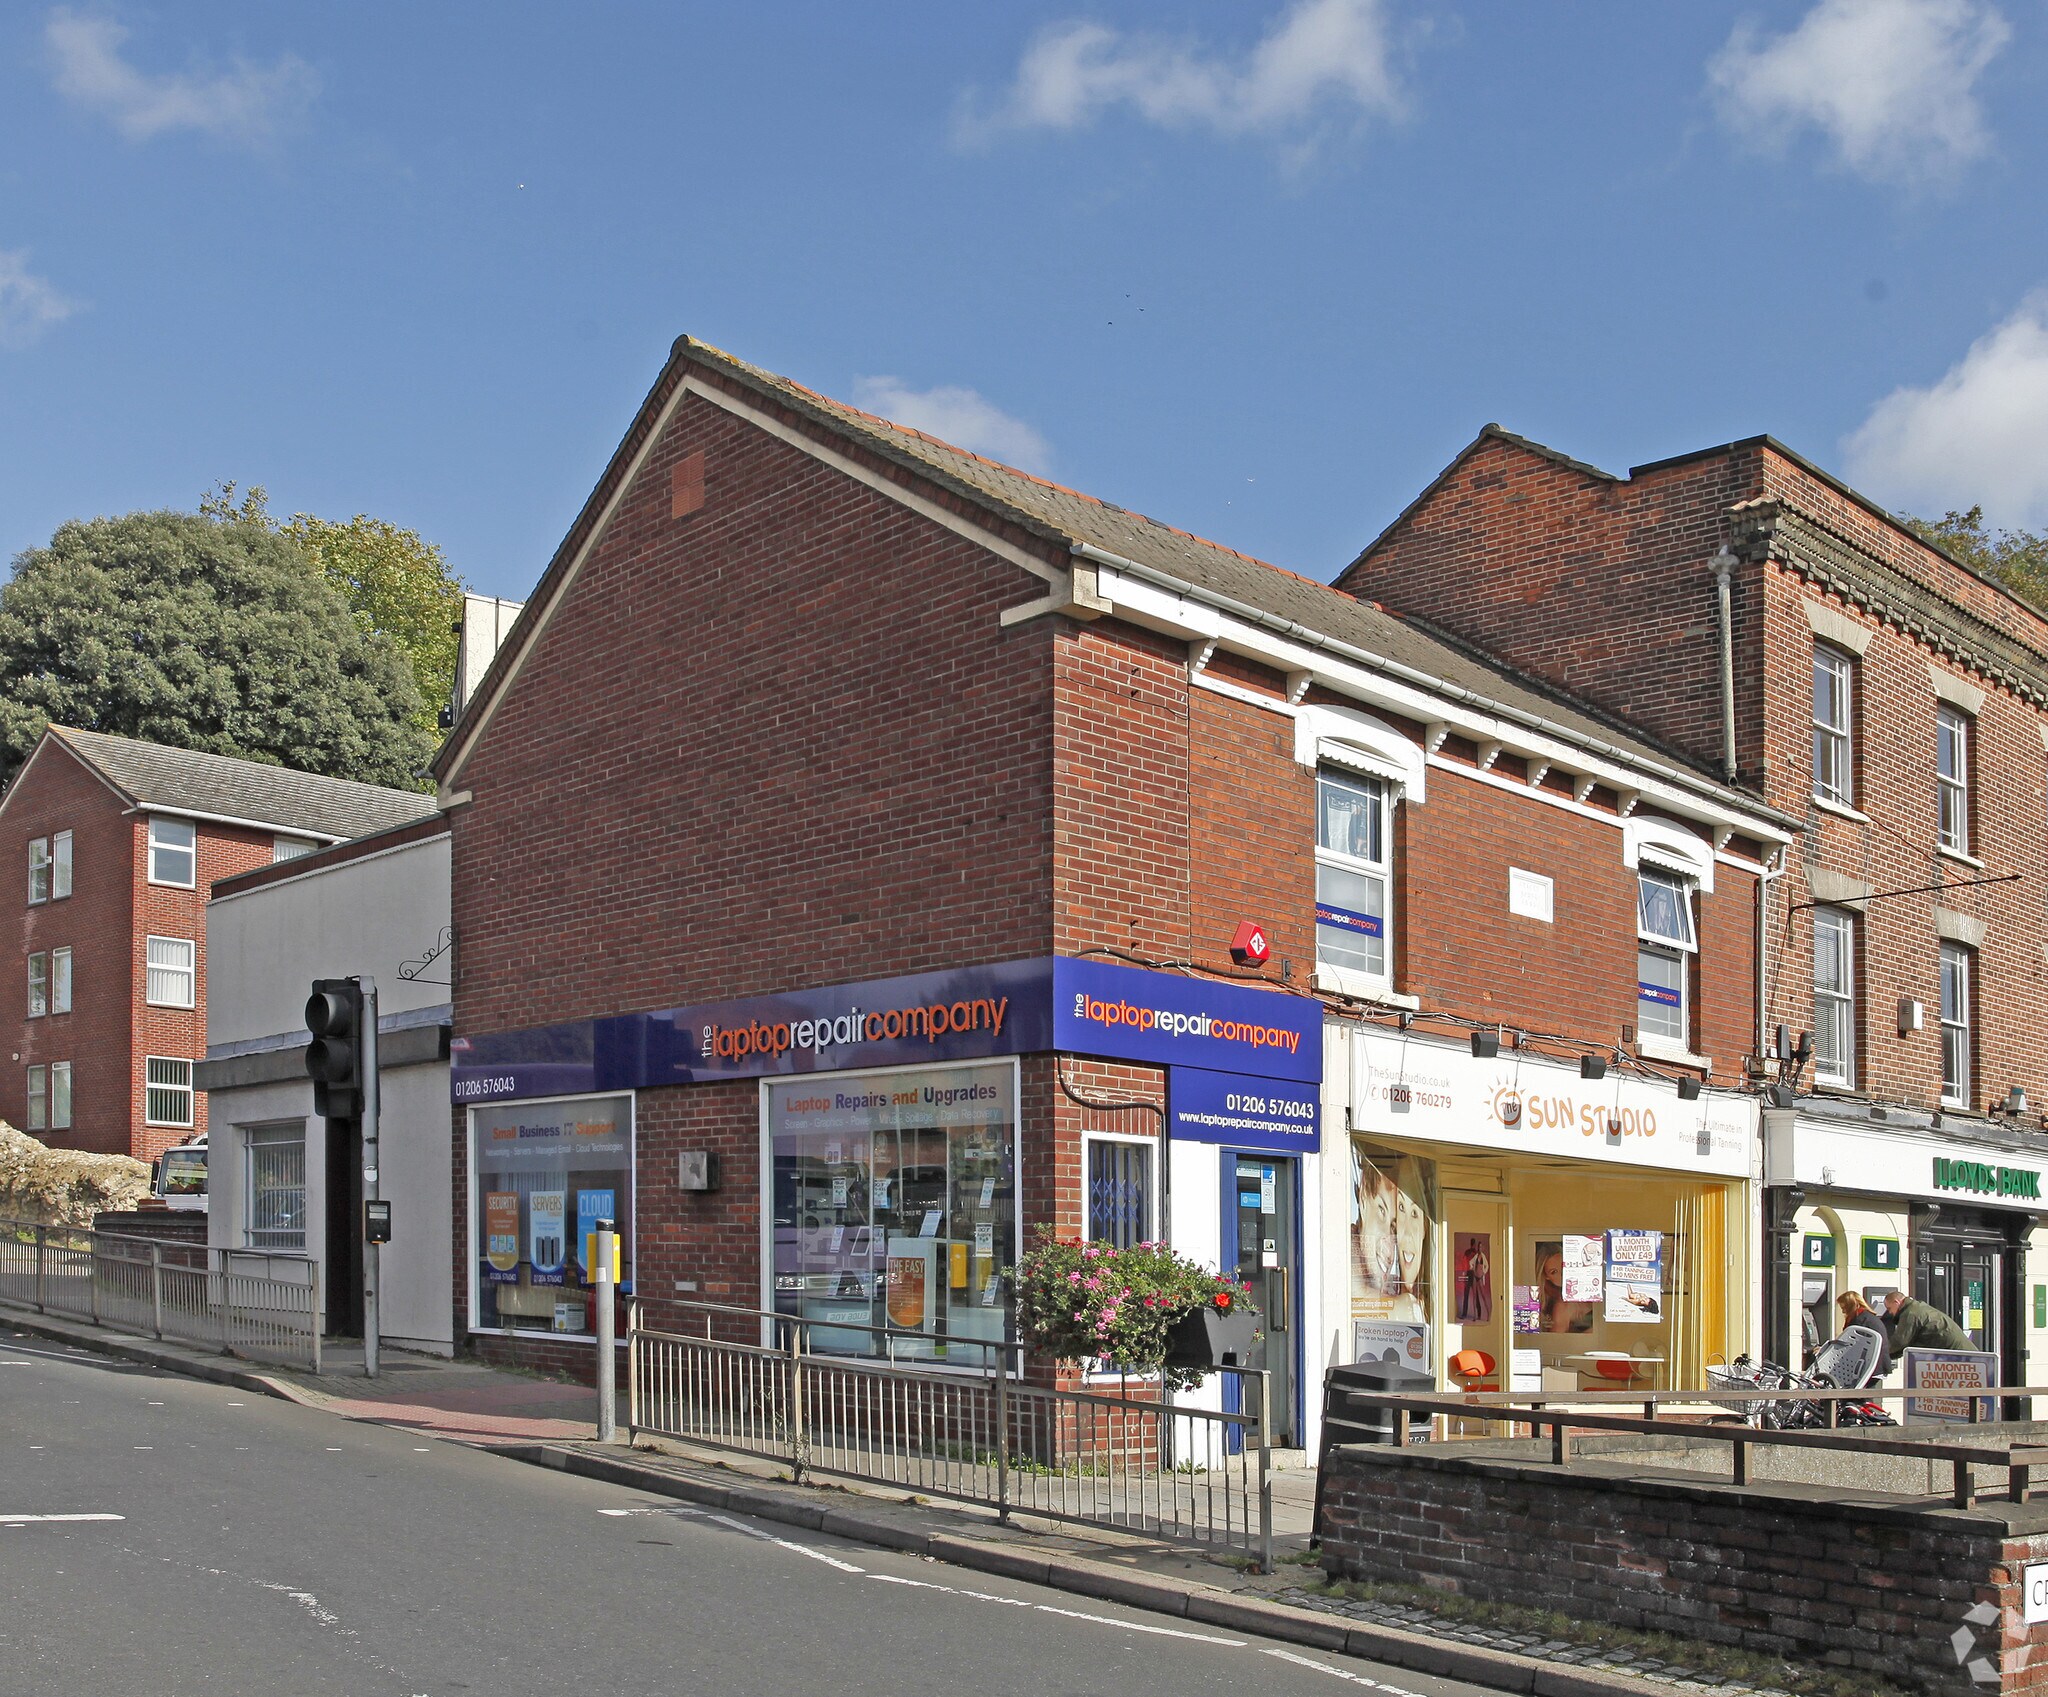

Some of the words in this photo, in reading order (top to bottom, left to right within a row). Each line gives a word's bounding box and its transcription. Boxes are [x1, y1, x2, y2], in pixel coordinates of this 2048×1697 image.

[1074, 993, 1084, 1018] the
[701, 1025, 712, 1058] the
[456, 1080, 481, 1096] 01206
[483, 1076, 515, 1094] 576043
[1369, 1066, 1450, 1088] TheSunStudio.co.uk
[786, 1096, 831, 1115] Laptop
[835, 1091, 887, 1112] Repairs
[892, 1088, 918, 1105] and
[924, 1083, 998, 1107] Upgrades
[1226, 1093, 1265, 1115] 01206
[1268, 1099, 1314, 1119] 576043
[1382, 1087, 1413, 1103] 01206
[1416, 1091, 1452, 1109] 760279
[785, 1119, 809, 1129] Screen
[814, 1117, 844, 1129] Graphics
[850, 1116, 870, 1126] Power
[940, 1110, 959, 1121] Data
[962, 1107, 999, 1121] Recovery
[1179, 1111, 1314, 1135] www.laptoprepaircompany.co.uk
[1527, 1095, 1575, 1130] SUN
[1580, 1104, 1657, 1137] STUDIO
[492, 1126, 517, 1140] Small
[520, 1125, 561, 1138] Business
[563, 1122, 574, 1136] IT
[576, 1121, 617, 1136] Support
[576, 1143, 590, 1153] Cloud
[591, 1142, 624, 1153] Technologies
[1679, 1131, 1717, 1147] Professional
[1718, 1137, 1742, 1152] Tanning
[1934, 1157, 1997, 1194] LLOYDS
[1999, 1167, 2042, 1200] BANK
[488, 1196, 517, 1210] SECURITY
[532, 1195, 563, 1211] SERVERS
[579, 1194, 612, 1217] CLOUD
[1615, 1252, 1637, 1260] ONLY
[1638, 1251, 1653, 1260] £49
[890, 1260, 903, 1273] THE
[905, 1260, 925, 1273] EASY
[1358, 1326, 1382, 1335] Broken
[1383, 1328, 1409, 1338] laptop?
[1921, 1371, 1979, 1380] UNLIMITED
[1926, 1363, 1931, 1371] 1
[1935, 1363, 1976, 1372] MONTH
[1921, 1380, 1955, 1388] ONLY
[1935, 1405, 1959, 1415] MINS
[1936, 1399, 1969, 1408] TANNING
